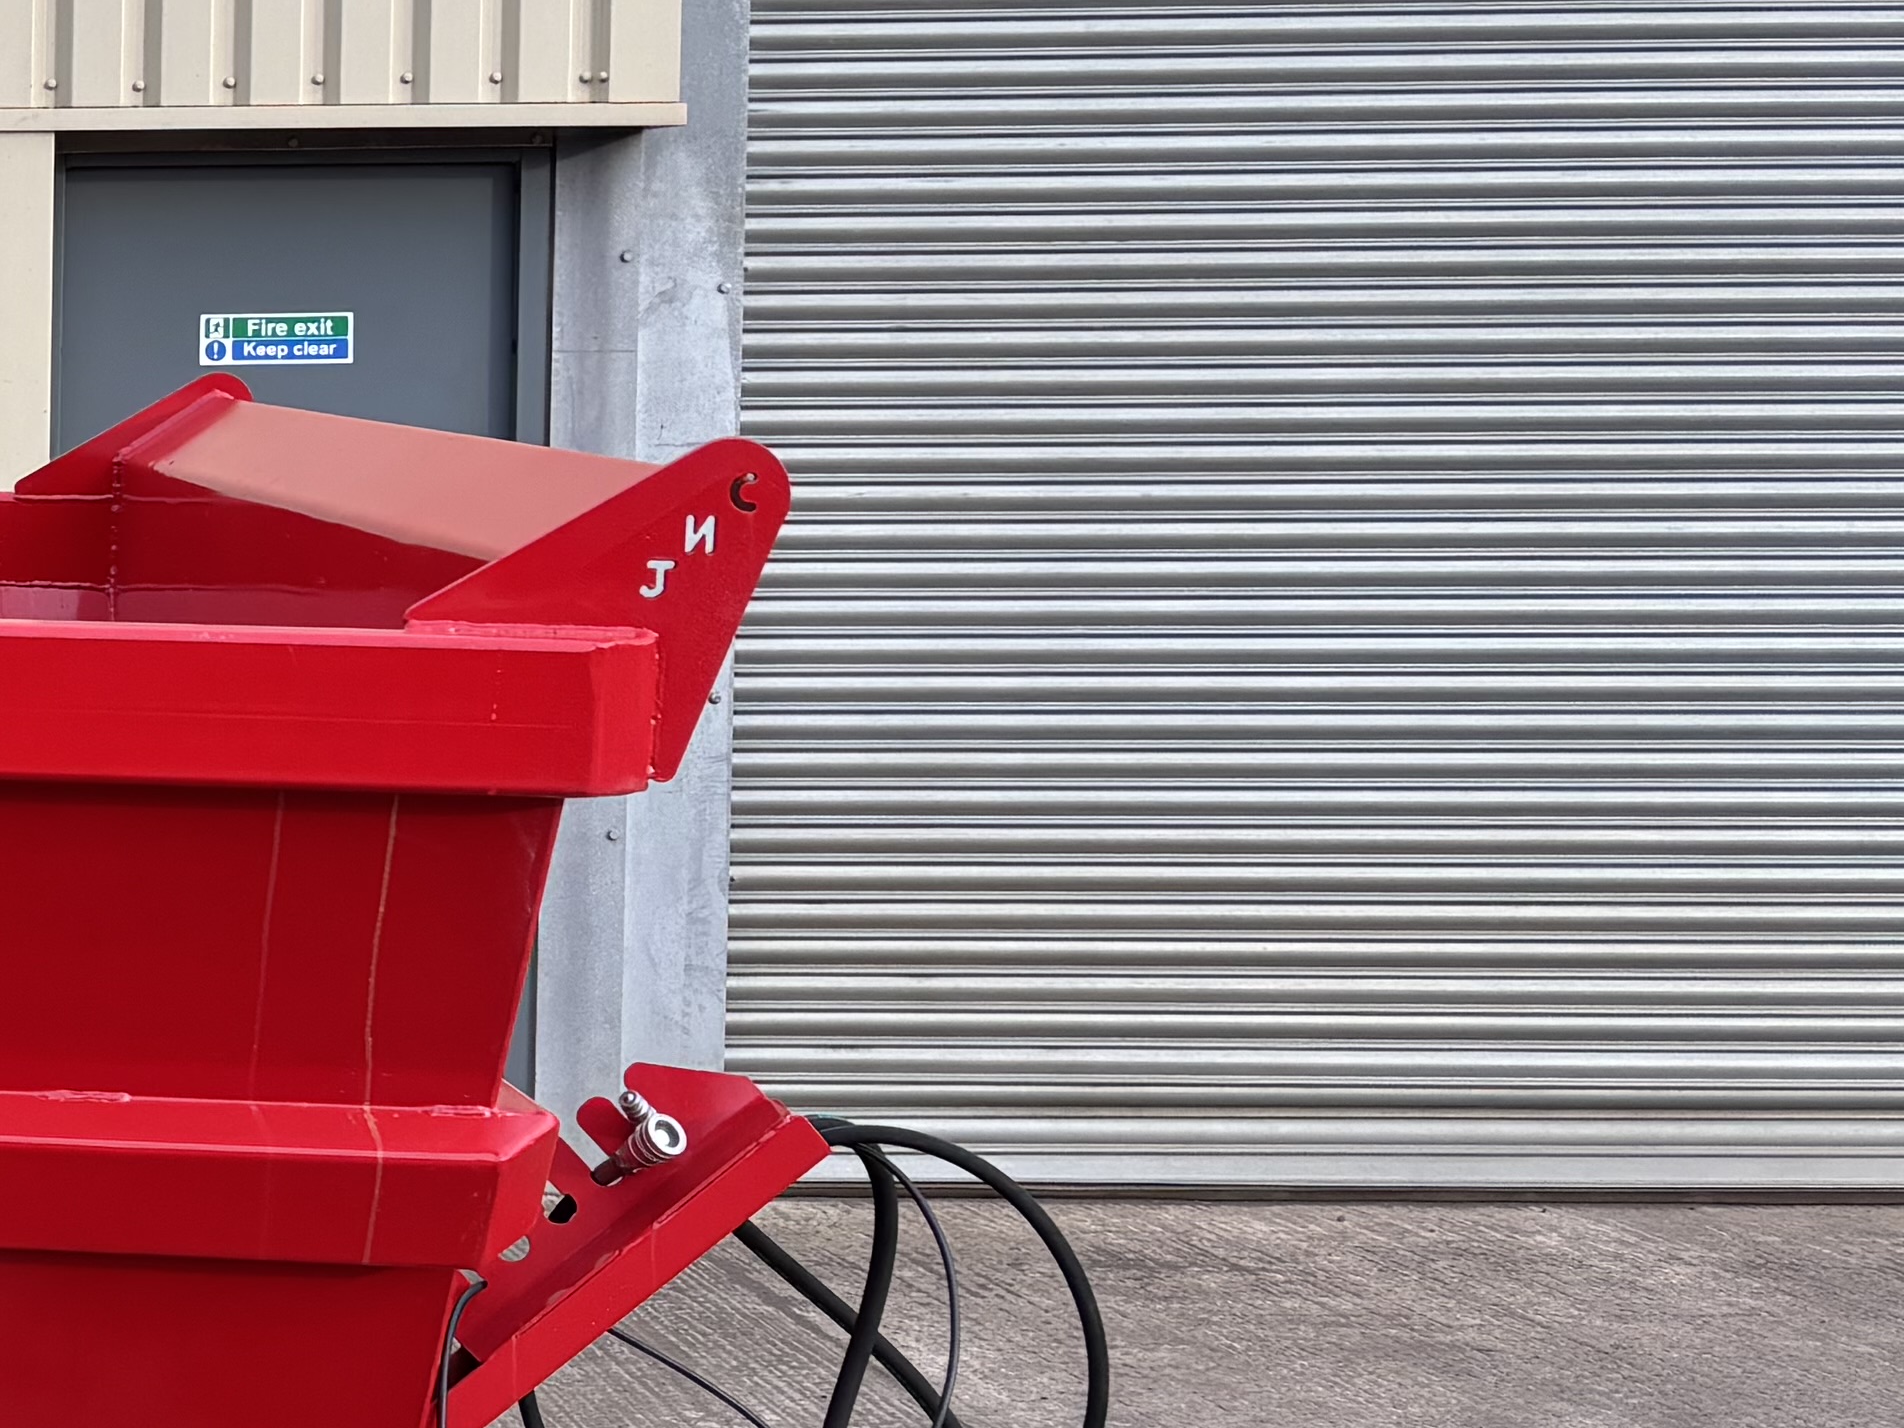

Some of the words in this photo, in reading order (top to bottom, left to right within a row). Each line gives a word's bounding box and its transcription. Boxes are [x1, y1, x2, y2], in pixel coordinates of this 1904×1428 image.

[247, 319, 288, 336] Fire
[294, 318, 334, 336] exit
[243, 342, 289, 359] Keep
[293, 341, 337, 356] clear
